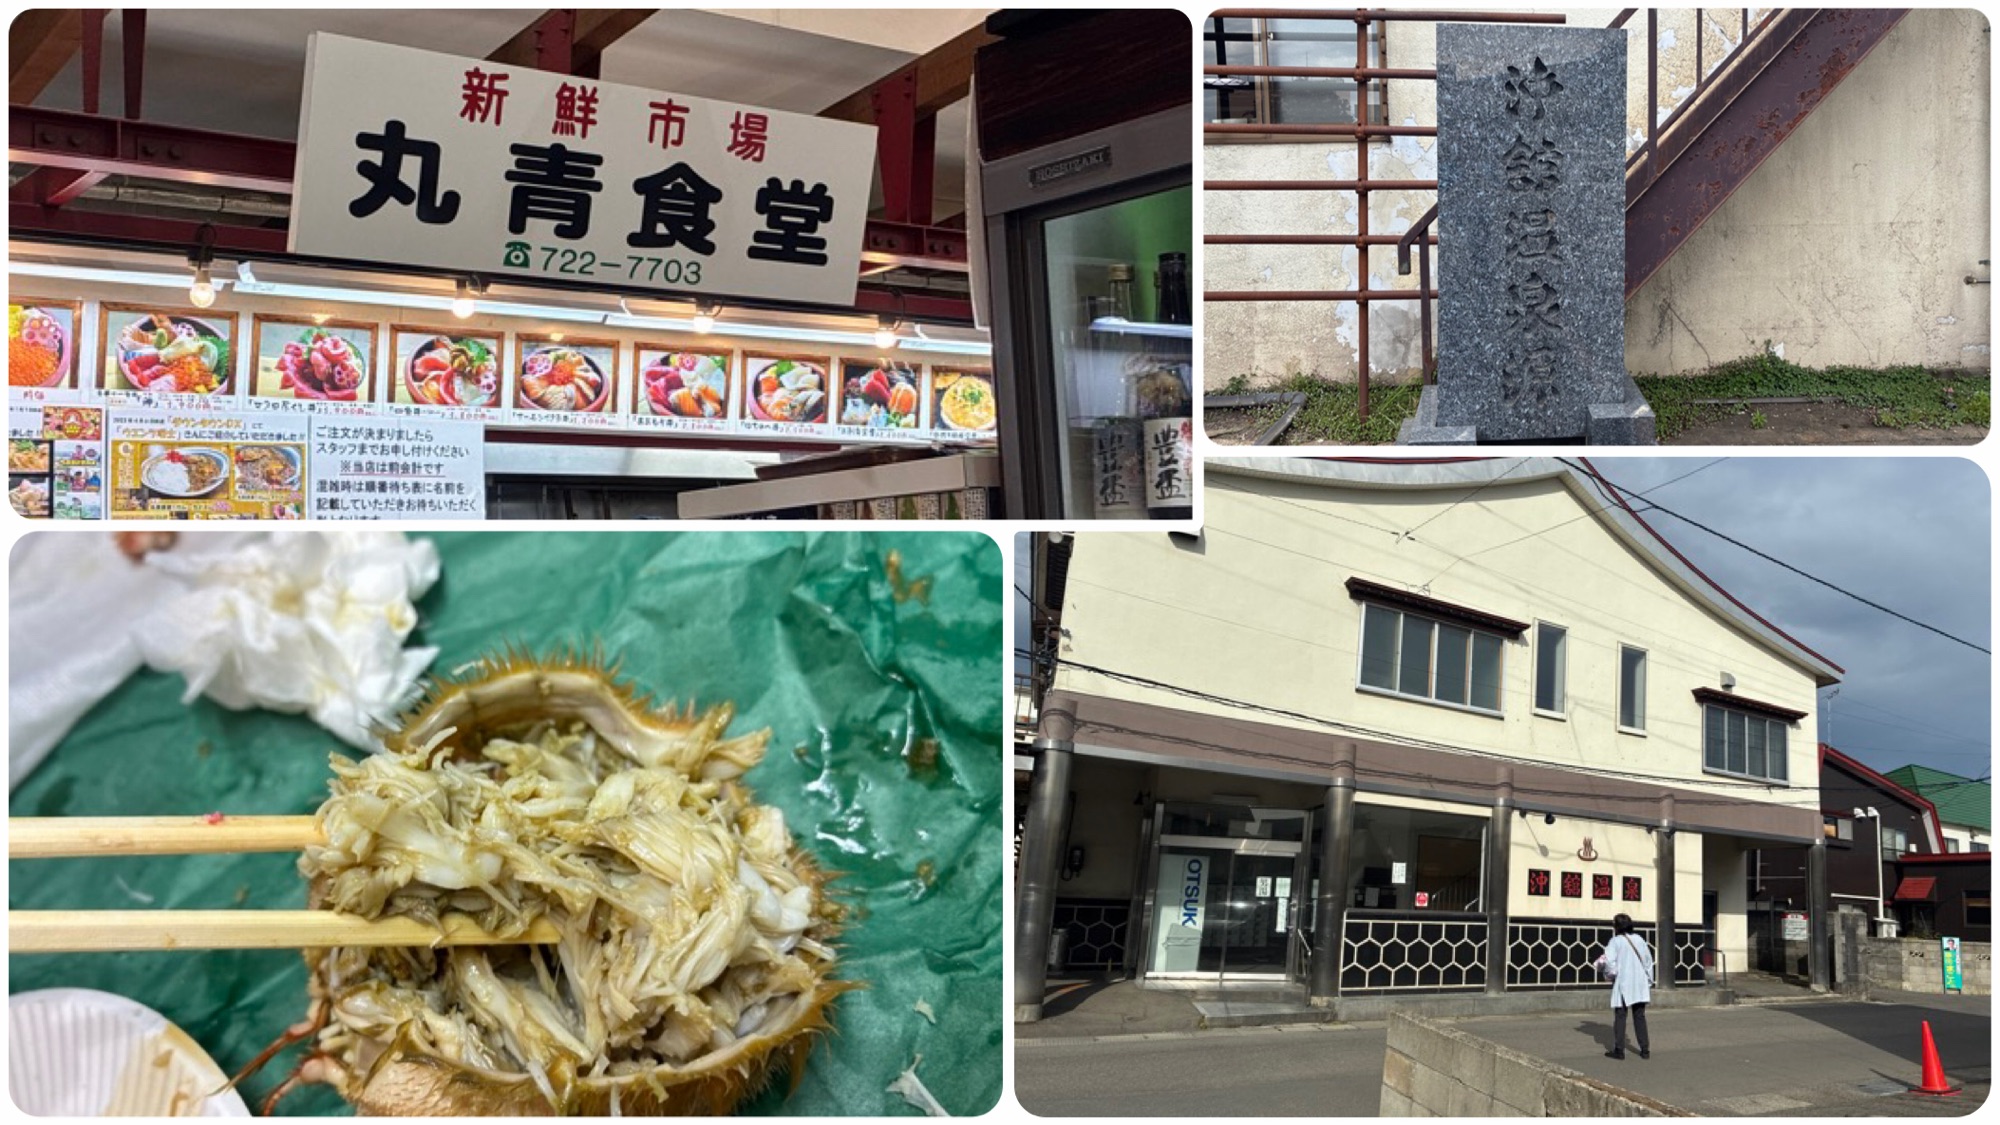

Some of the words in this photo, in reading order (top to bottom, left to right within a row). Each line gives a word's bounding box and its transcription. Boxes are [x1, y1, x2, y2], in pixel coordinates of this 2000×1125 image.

[460, 67, 768, 162] 新鮮市場
[1036, 152, 1104, 181] HOSHIZAKI
[348, 120, 834, 266] 丸青食堂
[316, 427, 434, 442] ご注文が決まりましたら
[316, 443, 470, 458] スタッフまでお申し付けください
[316, 479, 465, 495] 混雑時は順番待ち表に名前を
[316, 497, 477, 512] 記載していただきお待ちいただく
